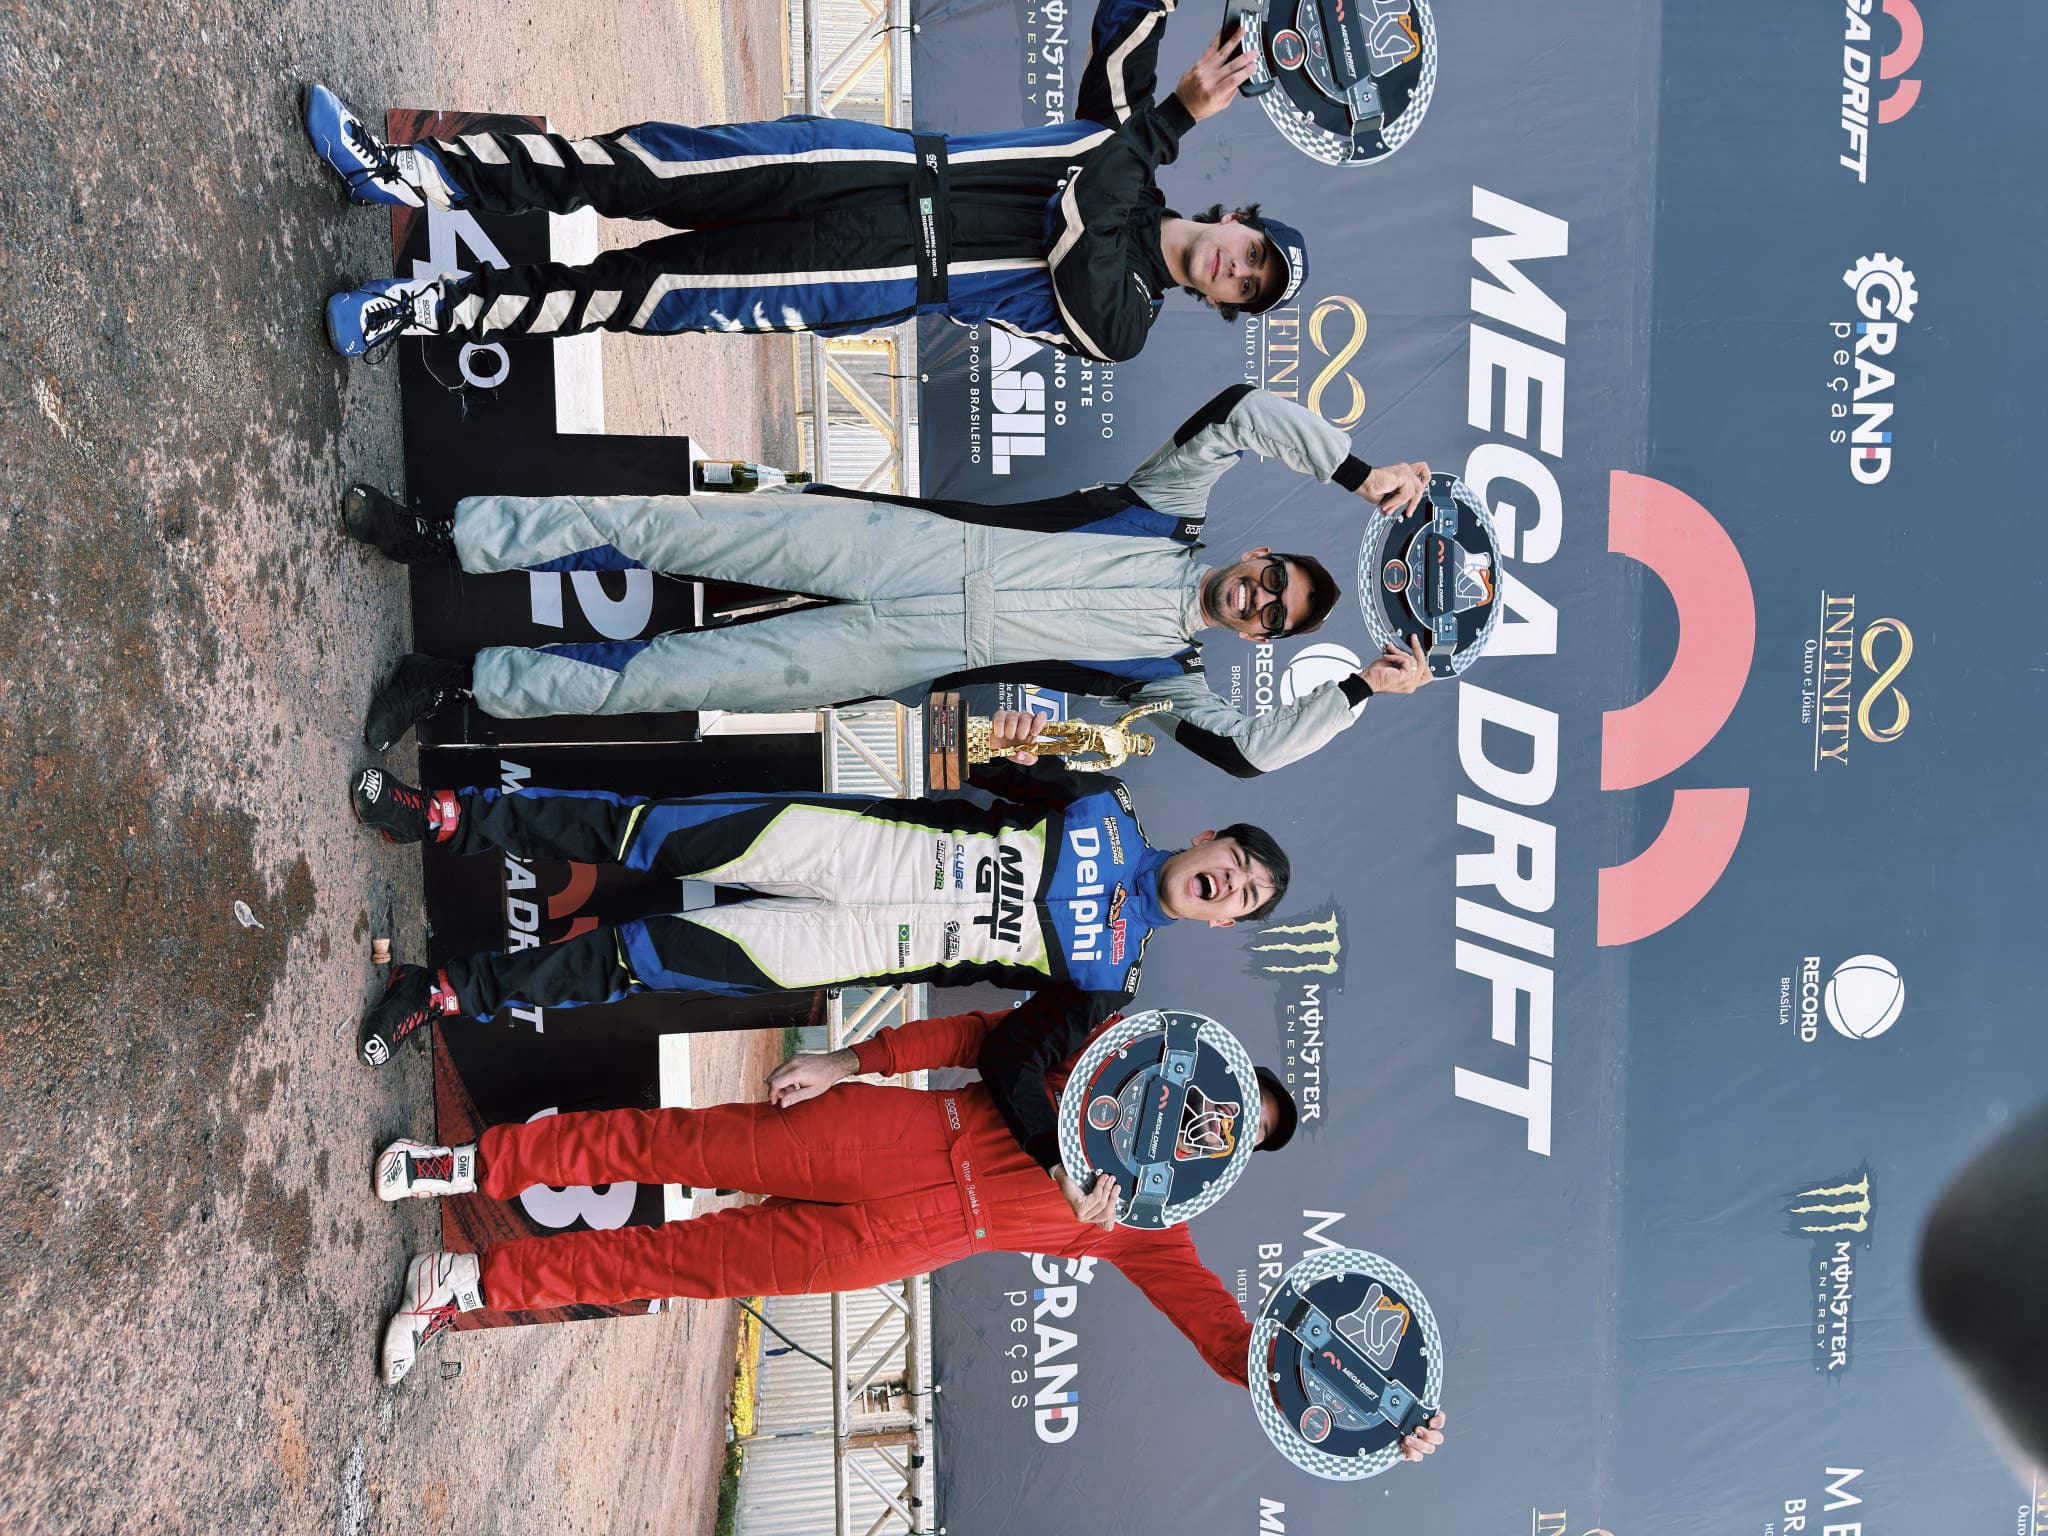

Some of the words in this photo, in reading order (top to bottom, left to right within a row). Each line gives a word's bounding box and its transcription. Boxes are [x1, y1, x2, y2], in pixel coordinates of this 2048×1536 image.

[1346, 49, 1357, 79] DRIFT
[1840, 45, 1870, 184] DRIFT
[1245, 317, 1260, 356] Ouro
[969, 346, 980, 383] POVO
[1245, 360, 1256, 369] e
[1827, 322, 1851, 444] peças
[1849, 268, 1901, 485] GRAND
[969, 388, 981, 464] BRASILEIRO
[1054, 400, 1066, 426] DO
[1101, 413, 1114, 439] DO
[1464, 185, 1569, 656] MEGA
[530, 570, 654, 641] 2
[1802, 639, 1818, 674] Ouro
[1819, 594, 1855, 766] INFINITY
[1800, 689, 1816, 724] Jóias
[1802, 678, 1812, 687] e
[364, 769, 380, 800] OMP
[1117, 788, 1133, 811] OMP
[444, 801, 453, 818] OMP
[500, 760, 536, 889] MA
[955, 844, 965, 890] CLUBE
[973, 856, 1000, 939] GT
[998, 845, 1024, 943] MINI
[1068, 827, 1104, 961] Delphi
[1454, 681, 1559, 1156] DRIFT
[506, 897, 544, 1034] DRT
[949, 933, 960, 960] FEAL
[1127, 967, 1139, 993] OMP
[1778, 977, 1792, 1025] BRASÍLIA
[1800, 956, 1820, 1042] RECORD
[1299, 983, 1324, 1124] MONSTER
[1149, 1133, 1159, 1160] DRIFT
[1153, 1111, 1164, 1135] MEGA
[459, 1155, 467, 1178] OMP
[1237, 1269, 1247, 1305] HOTEL
[1816, 1261, 1827, 1350] ENERGY
[1828, 1241, 1852, 1370] MONSTER
[1004, 1291, 1030, 1410] peças
[1031, 1254, 1080, 1444] GRAND
